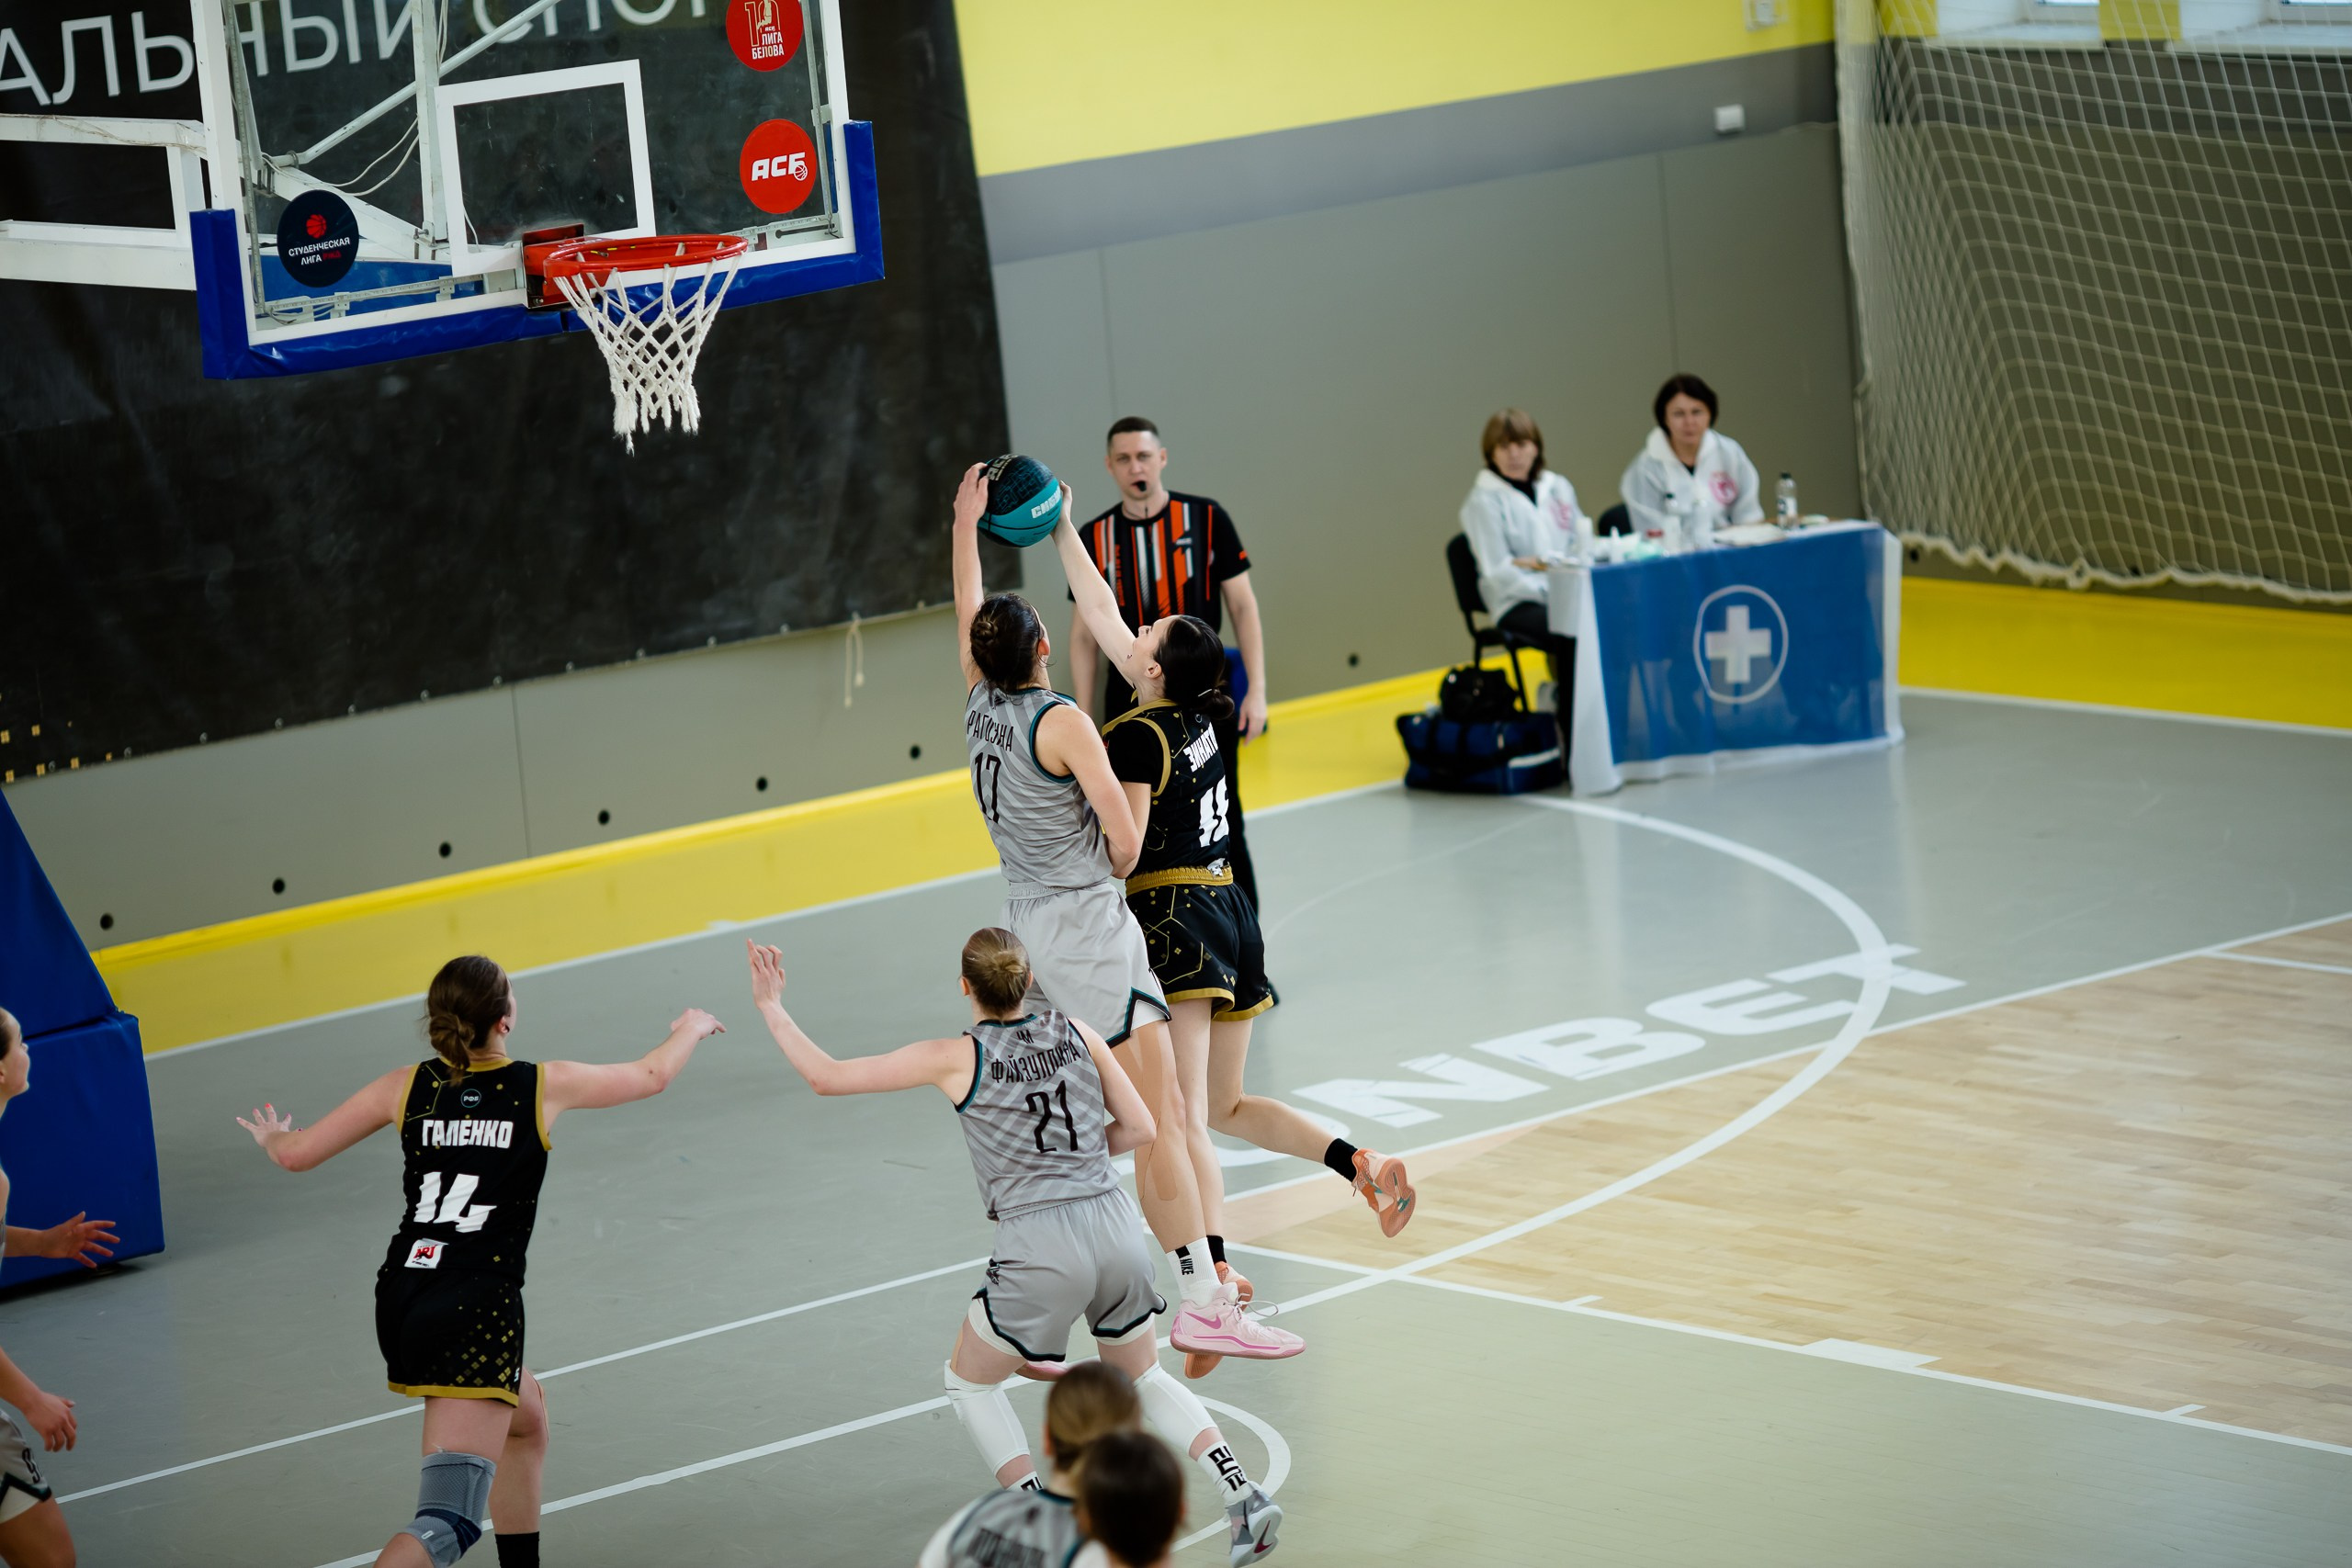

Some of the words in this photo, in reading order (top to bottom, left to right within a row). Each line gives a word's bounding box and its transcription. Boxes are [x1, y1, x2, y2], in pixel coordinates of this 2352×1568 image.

[762, 31, 783, 46] ЛИГА
[752, 152, 807, 182] АСБ
[288, 236, 351, 257] СТУДЕНЧЕСКАЯ
[300, 254, 322, 265] ЛИГА
[974, 751, 1002, 824] 17
[990, 1039, 1082, 1084] ФАЙЗУЛЛИНА
[1024, 1079, 1079, 1154] 21
[422, 1119, 514, 1149] ГАЛЕНКО
[413, 1171, 498, 1233] 14
[1179, 1258, 1194, 1276] NIKE
